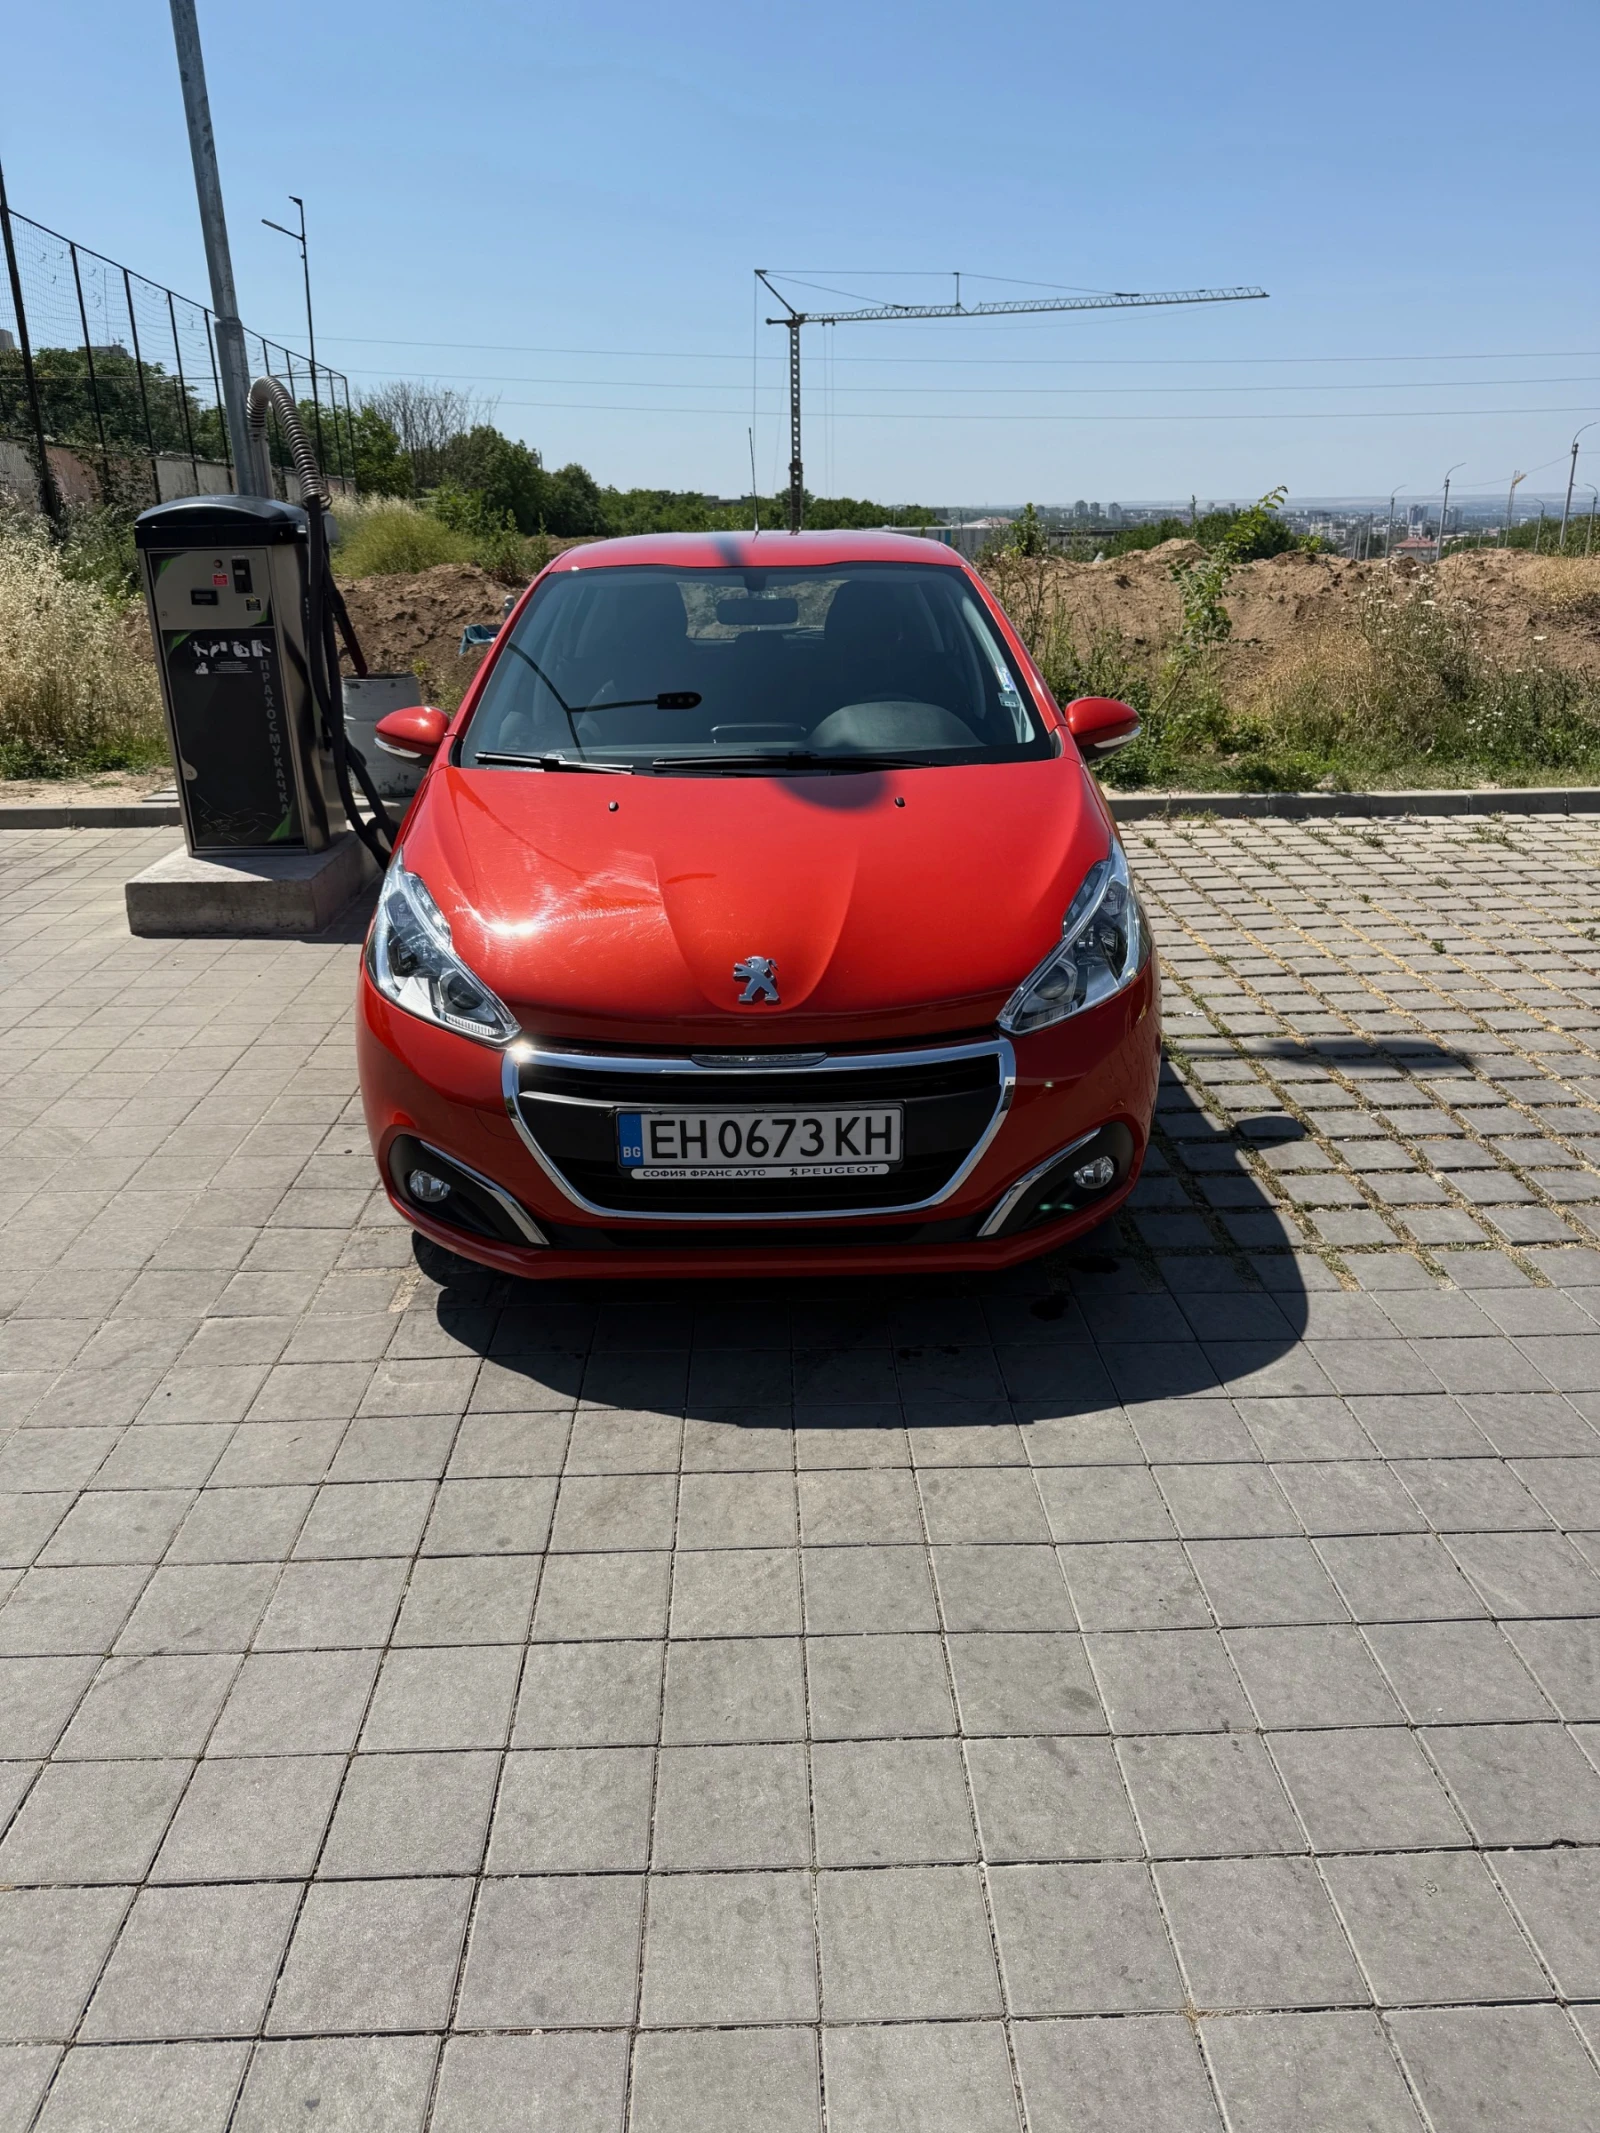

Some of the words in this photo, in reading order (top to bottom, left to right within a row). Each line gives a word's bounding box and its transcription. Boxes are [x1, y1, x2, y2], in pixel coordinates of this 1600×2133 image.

[259, 659, 289, 815] ПРАХОСМУКАЧКА
[718, 1118, 825, 1159] 0673
[622, 1146, 642, 1159] BG
[642, 1169, 687, 1178] СОФИЯ
[690, 1168, 733, 1178] ФРАНС
[735, 1168, 767, 1177] АУТО
[800, 1165, 879, 1175] PEUGEOT
